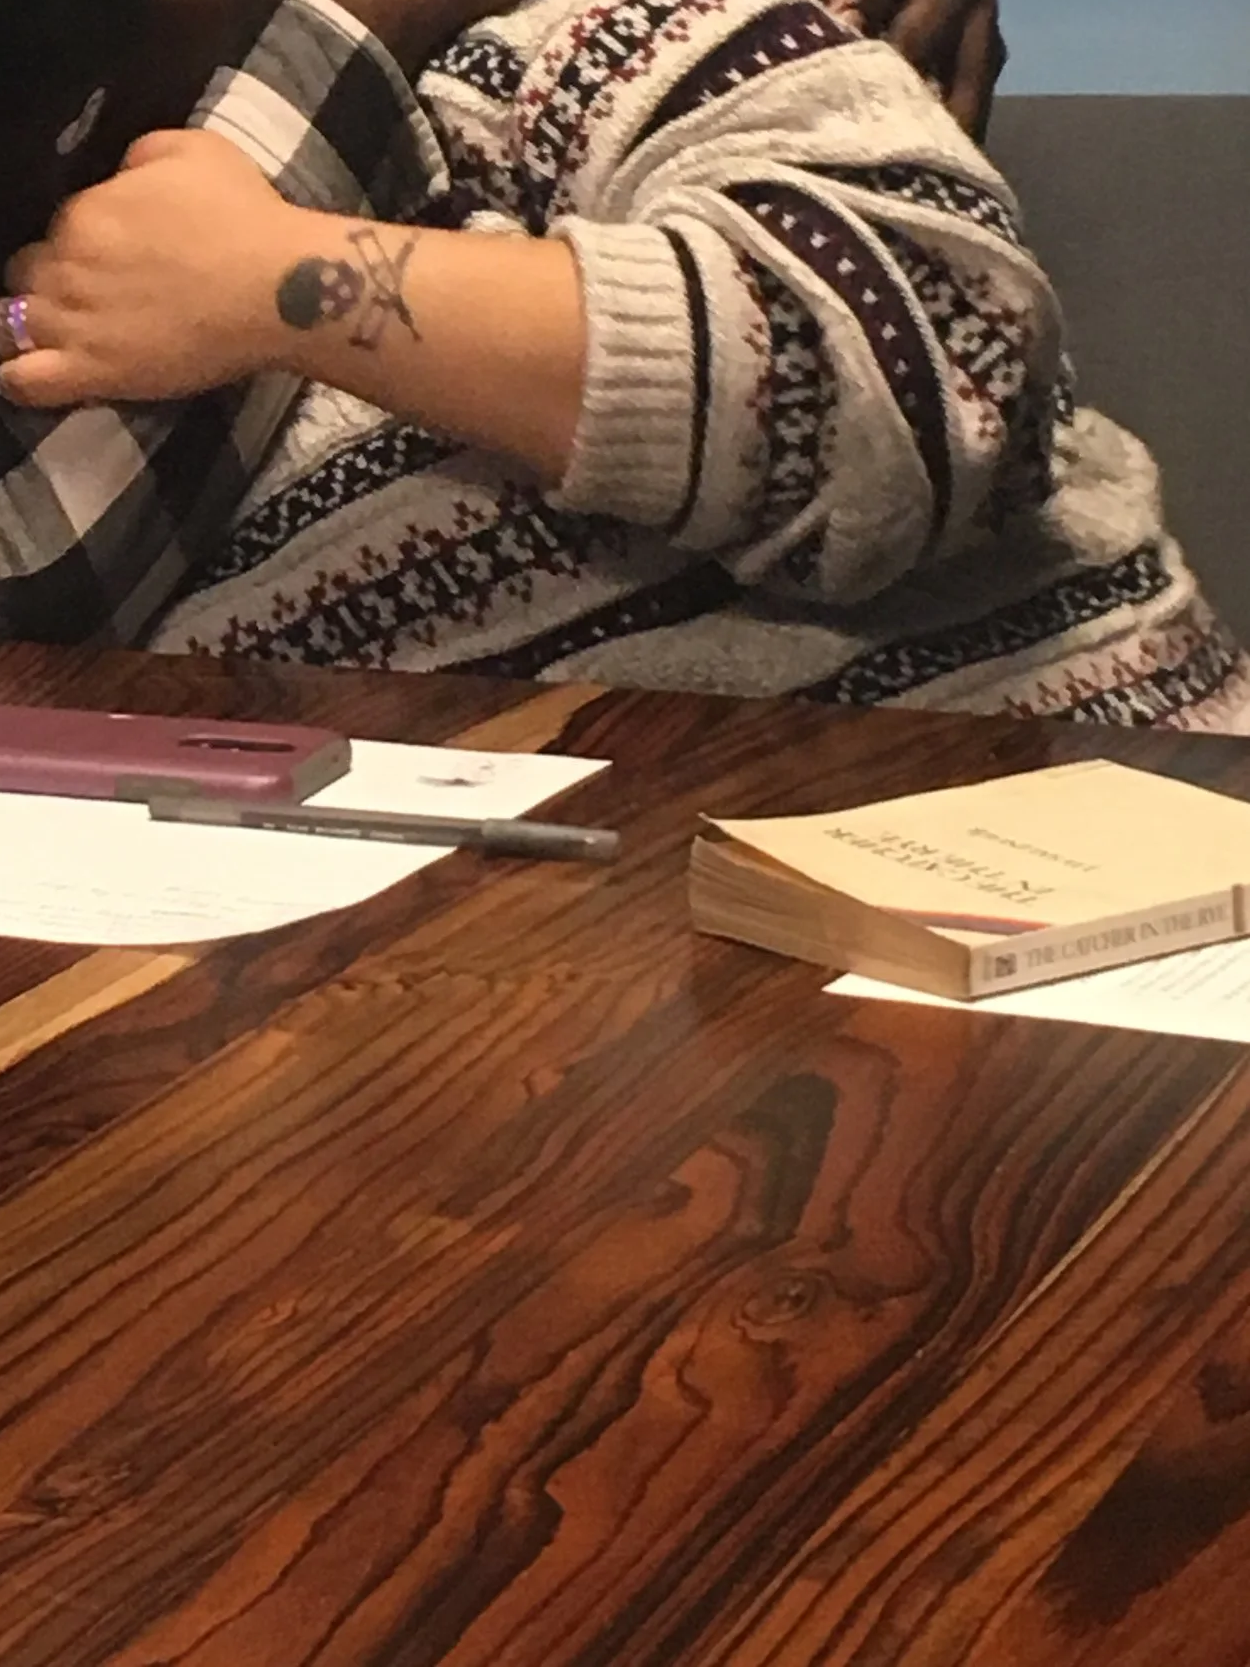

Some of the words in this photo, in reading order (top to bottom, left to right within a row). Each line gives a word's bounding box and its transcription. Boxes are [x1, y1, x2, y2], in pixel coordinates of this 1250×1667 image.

[1024, 945, 1055, 967] THE
[1061, 927, 1137, 958] CATCHER
[1140, 922, 1160, 940] IN
[1162, 913, 1192, 935] THE
[1198, 904, 1231, 926] RYE
